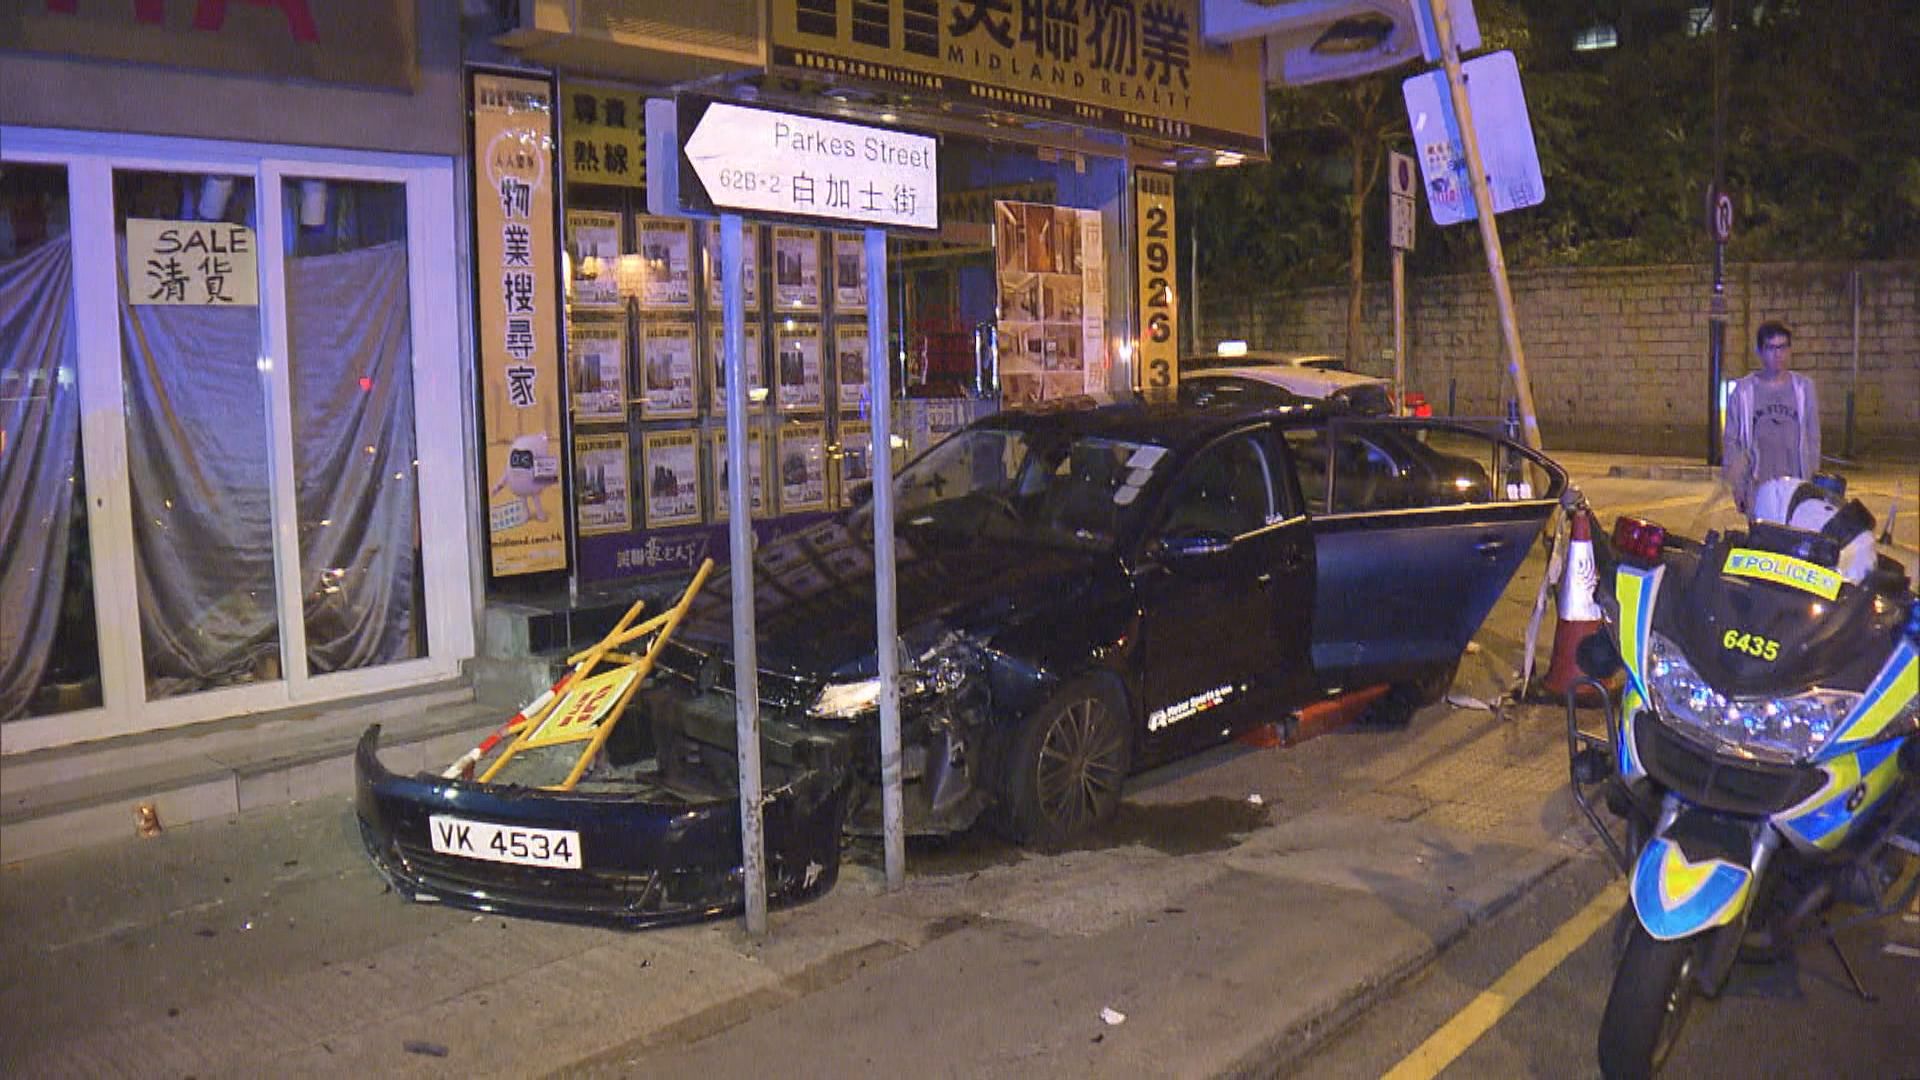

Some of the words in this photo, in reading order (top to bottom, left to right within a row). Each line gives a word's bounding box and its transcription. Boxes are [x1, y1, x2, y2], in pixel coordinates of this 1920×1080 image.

[947, 44, 1085, 88] MIDLAND
[1101, 77, 1192, 110] REALTY
[774, 121, 856, 158] Parkes
[864, 137, 930, 170] Street
[791, 170, 917, 217] 白加士街
[153, 228, 249, 254] SALE
[146, 257, 233, 304] 清貨
[500, 178, 536, 406] 物業搜尋家
[1745, 556, 1820, 585] POLICE
[1722, 629, 1781, 662] 6435
[438, 821, 474, 852] VK
[489, 830, 573, 863] 4534
